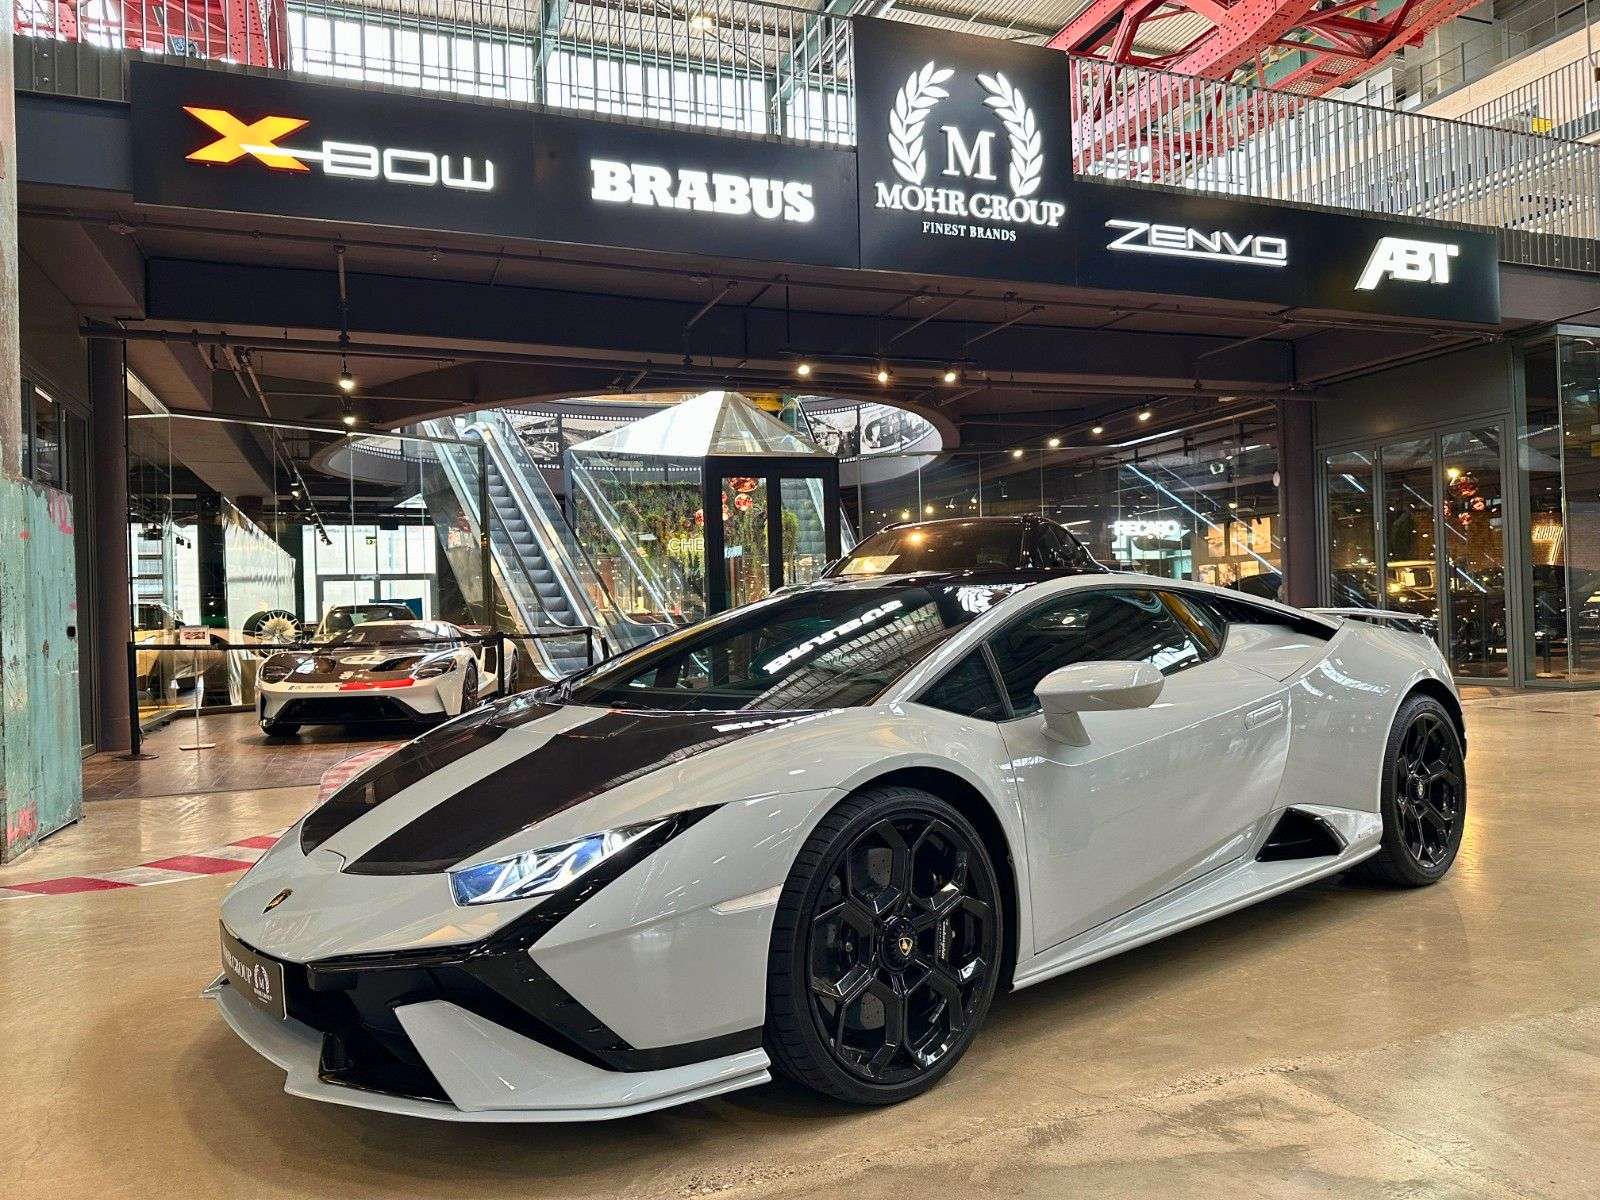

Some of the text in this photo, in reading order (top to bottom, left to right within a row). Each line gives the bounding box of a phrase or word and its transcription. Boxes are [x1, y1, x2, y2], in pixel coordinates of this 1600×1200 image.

[940, 122, 999, 182] M
[589, 157, 817, 226] BRABUS
[874, 182, 1067, 228] MOHR GROUP
[921, 221, 1018, 242] FINEST BRANDS
[1105, 219, 1290, 268] ZENVO
[1354, 236, 1461, 291] ABT
